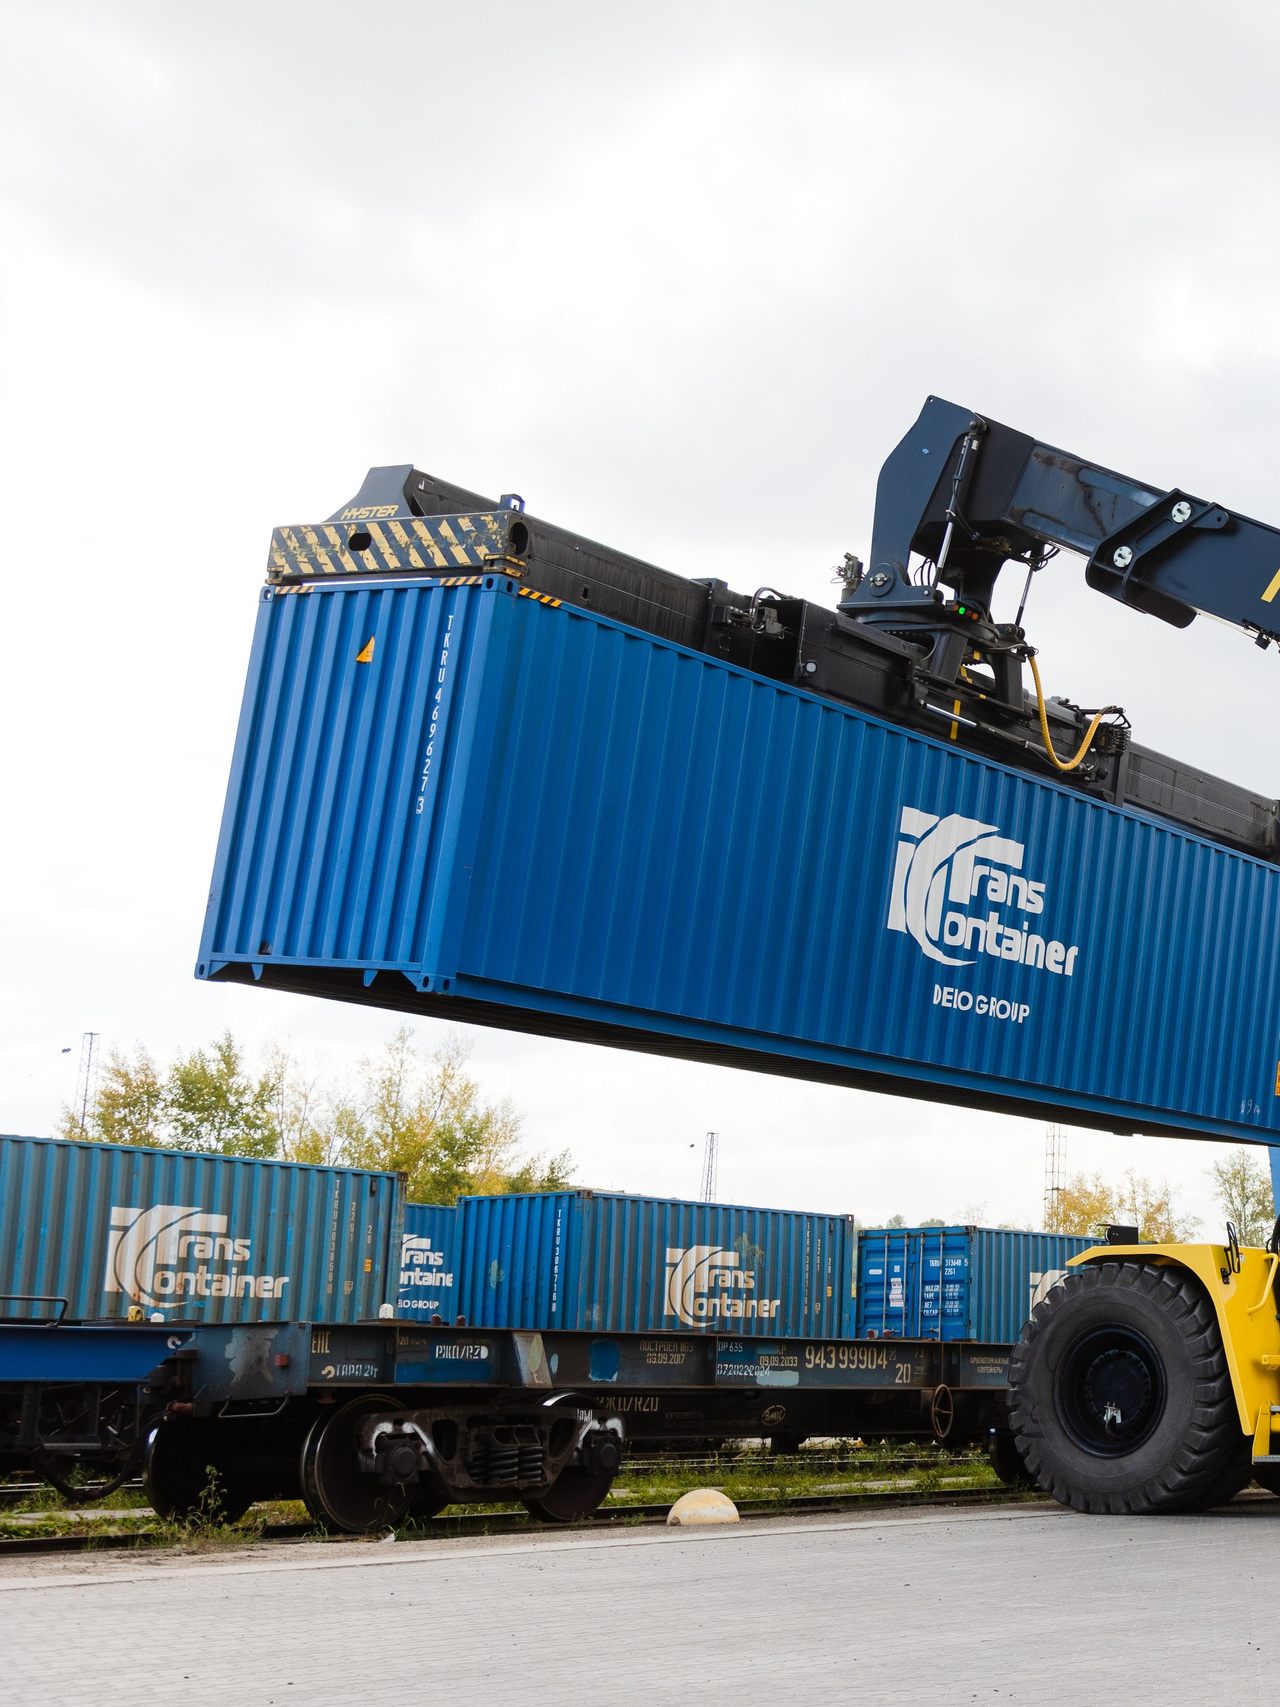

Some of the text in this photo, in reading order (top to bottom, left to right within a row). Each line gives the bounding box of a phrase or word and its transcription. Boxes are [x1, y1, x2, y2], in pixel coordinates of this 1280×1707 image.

[340, 504, 399, 521] HYSTER
[933, 983, 1030, 1024] DELO GROUP
[411, 1299, 439, 1310] GROUP
[639, 1341, 678, 1352] ПОСТРОЕН
[895, 1363, 911, 1384] 20
